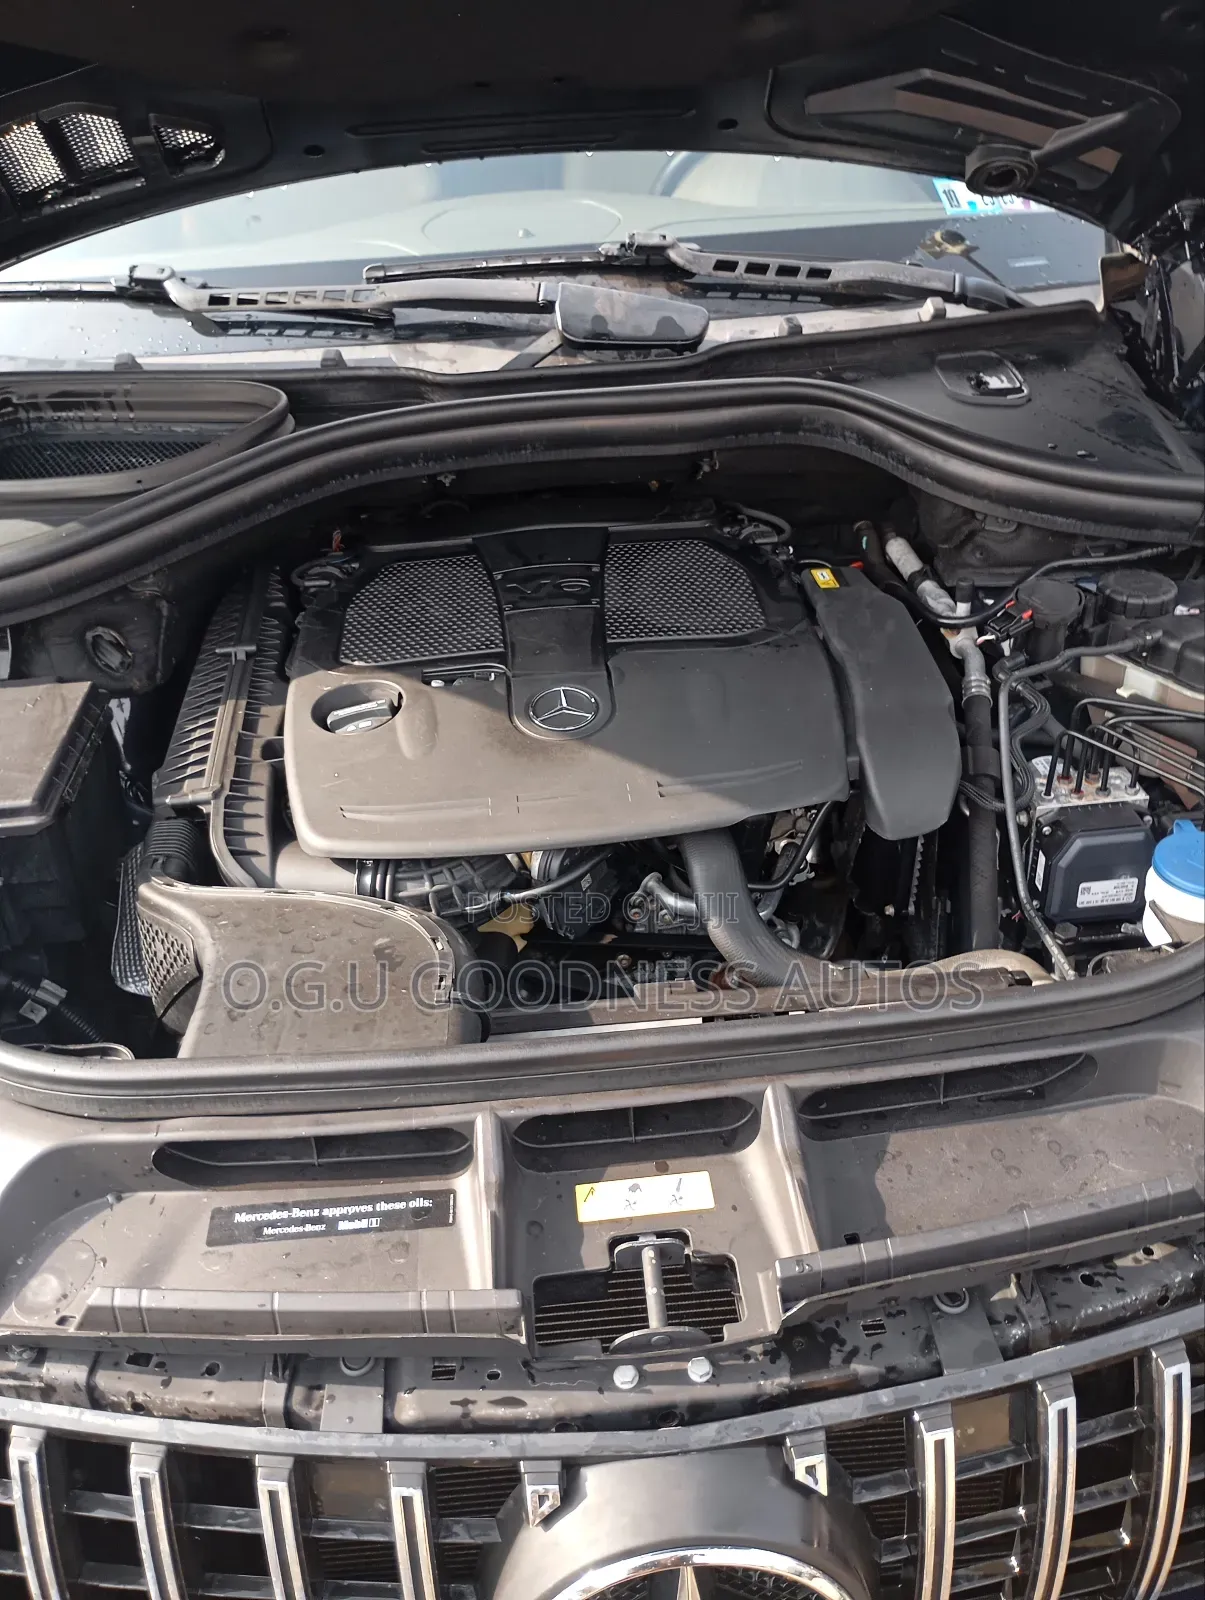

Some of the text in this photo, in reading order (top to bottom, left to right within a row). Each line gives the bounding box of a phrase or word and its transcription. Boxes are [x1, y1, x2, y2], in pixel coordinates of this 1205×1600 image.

[234, 1207, 320, 1223] Mercedes-Benz
[321, 1203, 374, 1218] approves
[376, 1200, 407, 1212] these
[262, 1223, 327, 1236] Mercedes-Benz
